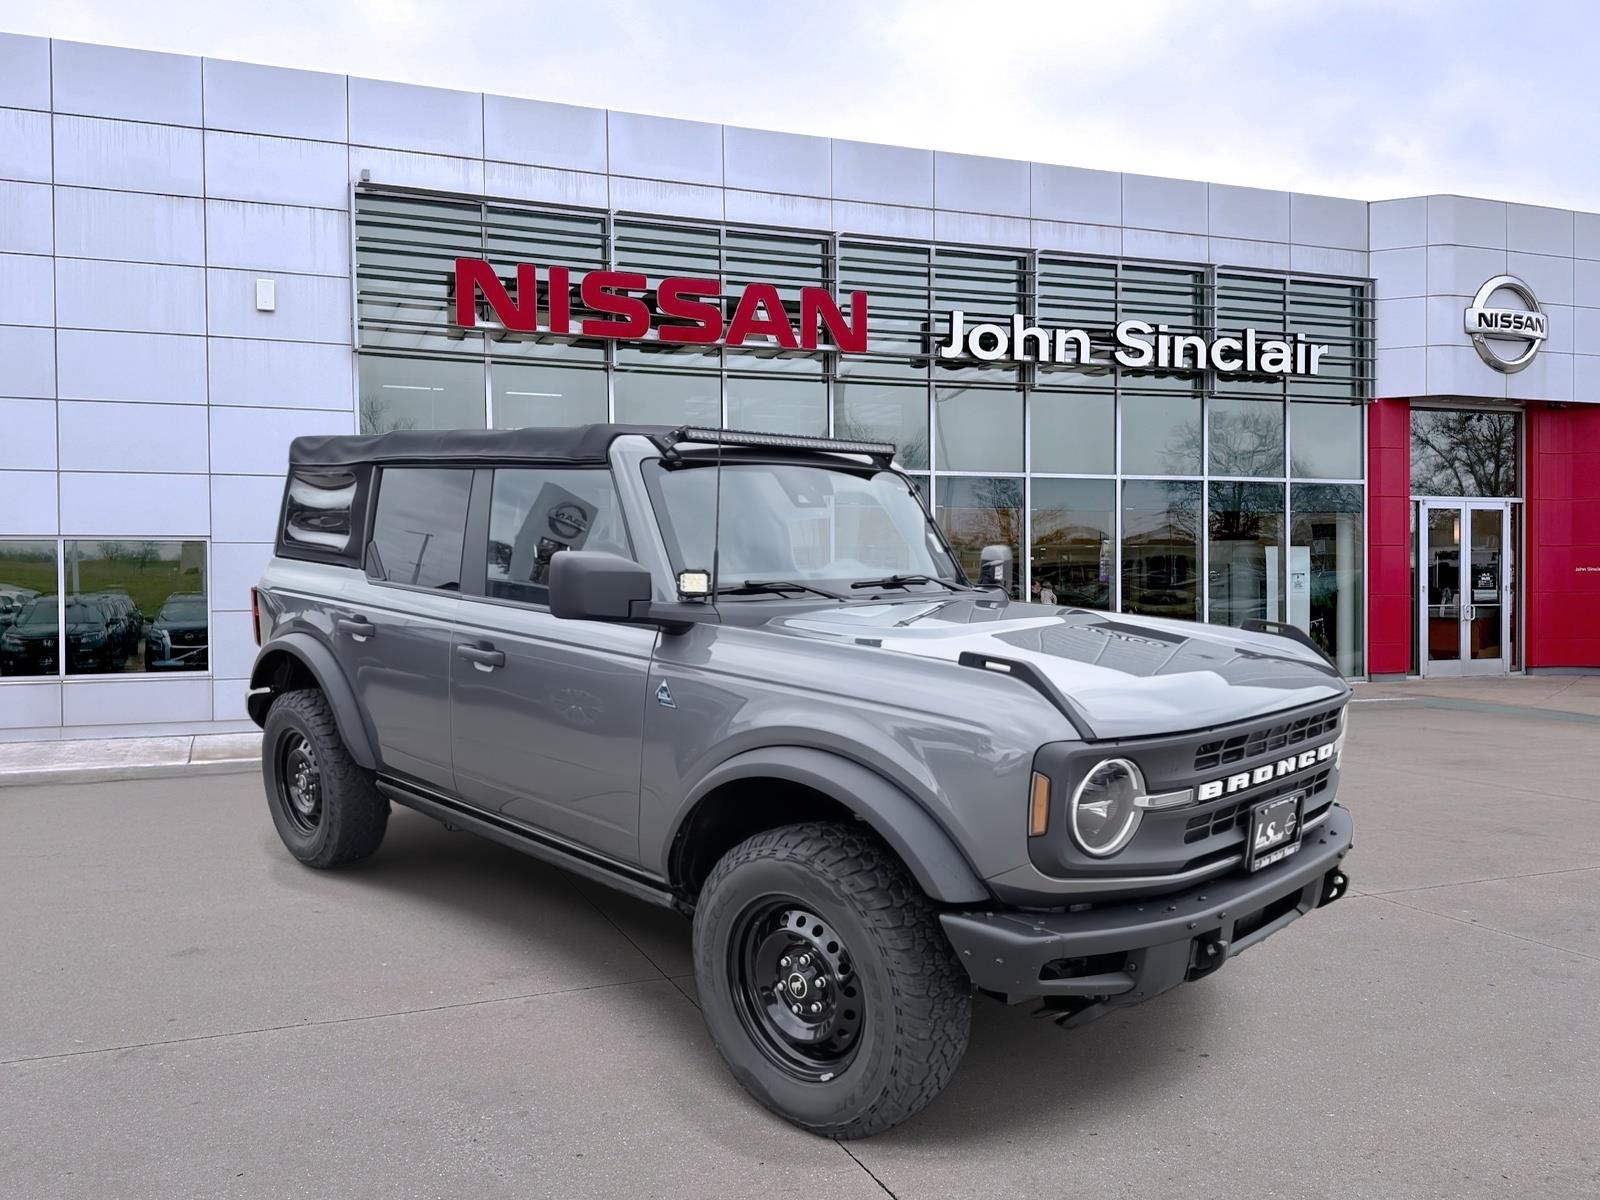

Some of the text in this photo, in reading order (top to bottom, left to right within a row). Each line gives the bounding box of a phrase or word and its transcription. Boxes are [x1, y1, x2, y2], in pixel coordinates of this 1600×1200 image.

[454, 257, 868, 353] NISSAN
[1478, 312, 1545, 333] NISSAN
[940, 310, 1329, 375] John Sinclair
[1198, 743, 1334, 801] BRONCO
